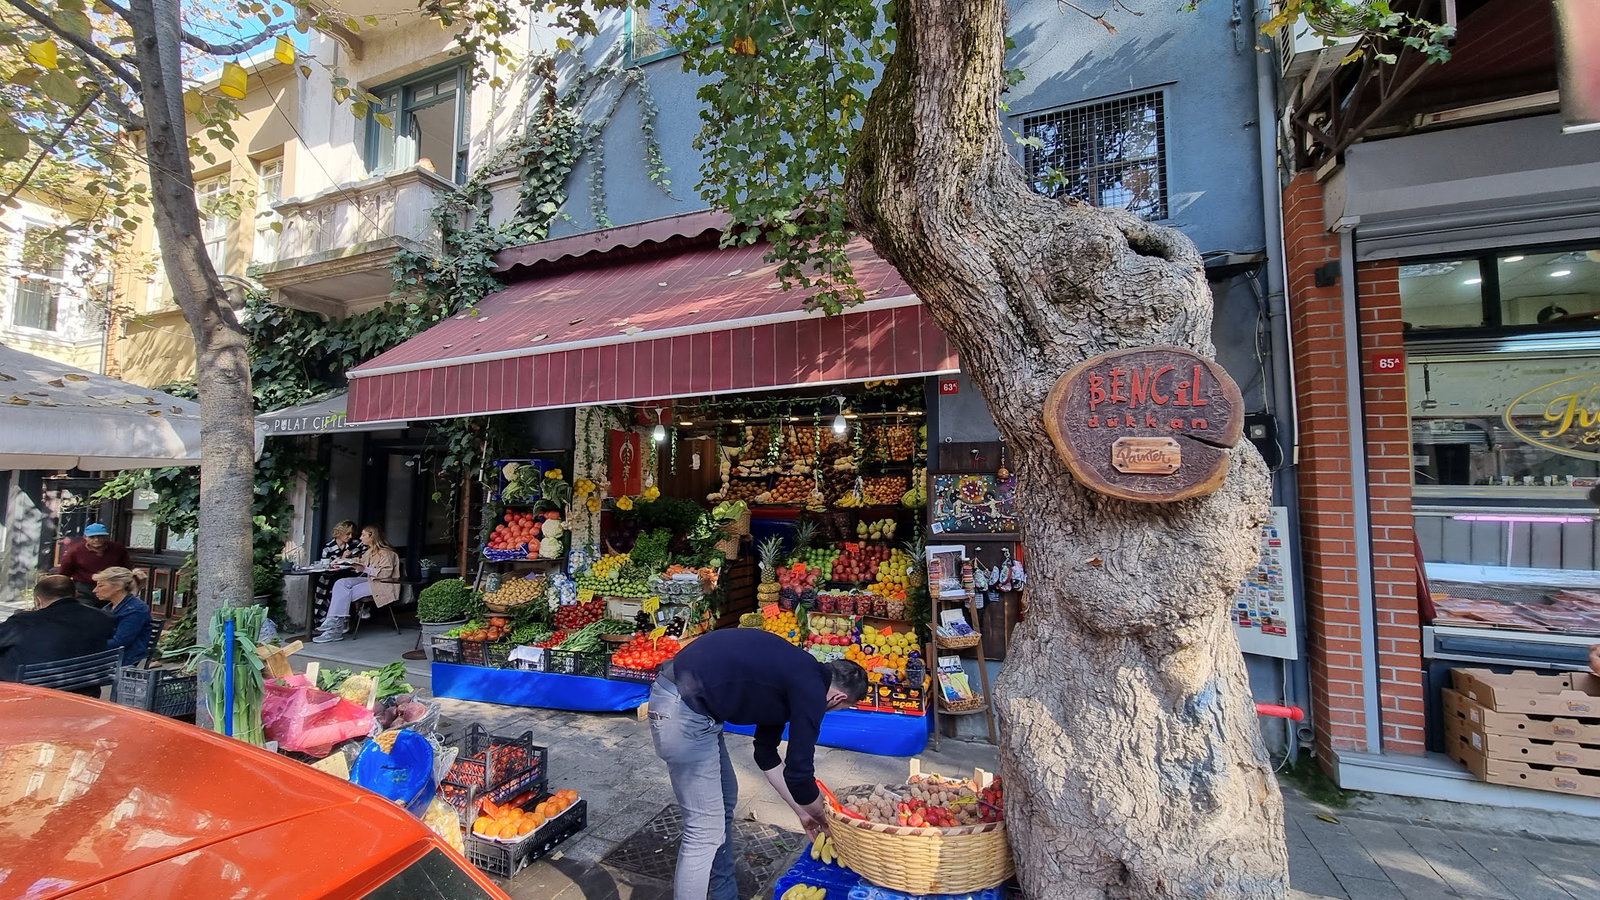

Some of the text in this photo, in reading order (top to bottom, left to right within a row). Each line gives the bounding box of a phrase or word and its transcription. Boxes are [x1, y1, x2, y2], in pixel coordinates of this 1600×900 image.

[1379, 358, 1400, 369] 65A
[1087, 414, 1208, 429] dükkan
[1116, 446, 1171, 469] Painter
[892, 700, 920, 709] uçak
